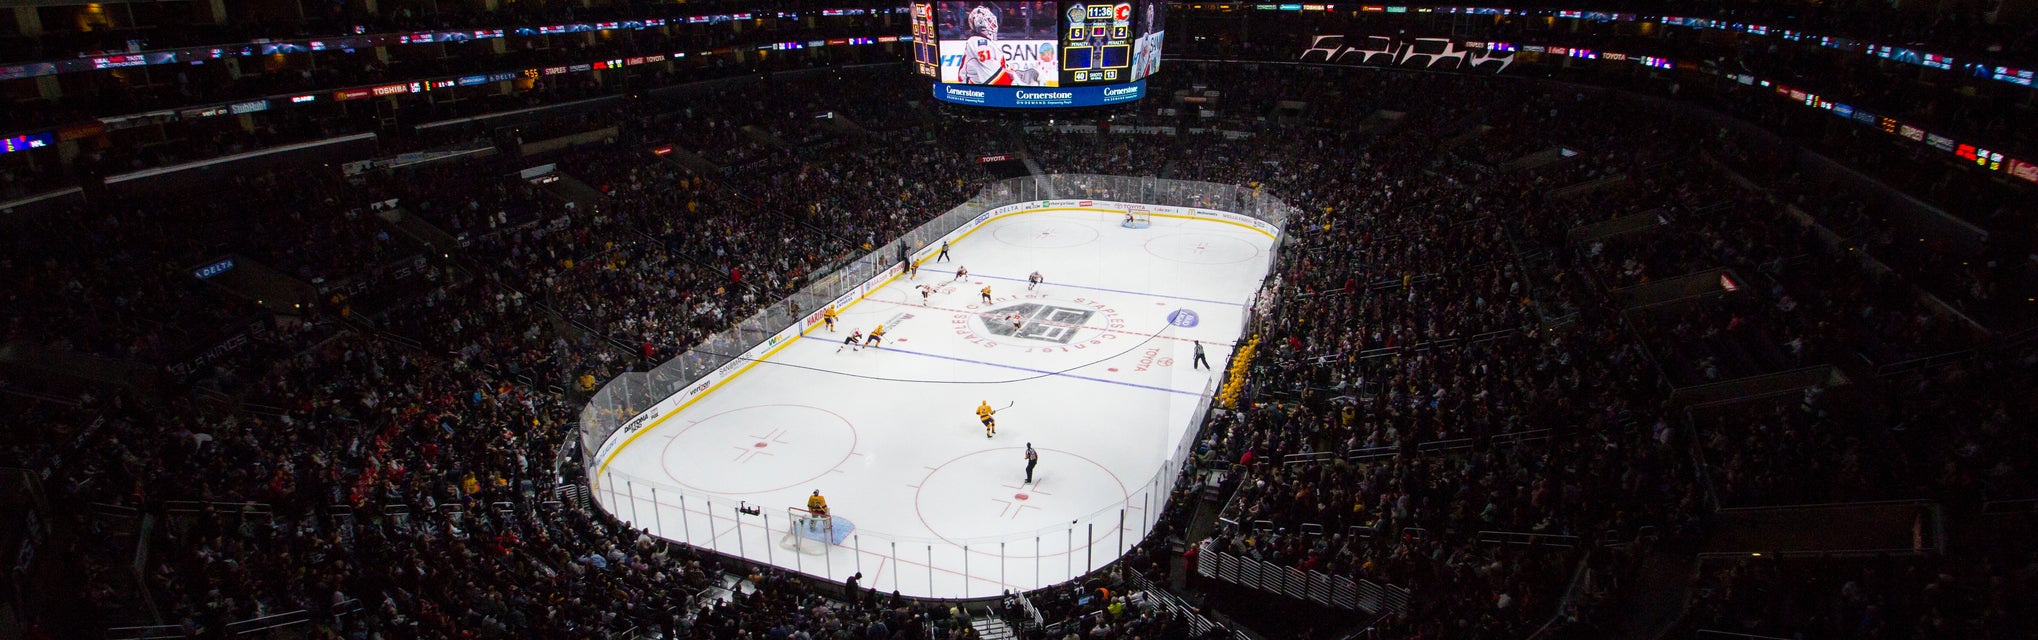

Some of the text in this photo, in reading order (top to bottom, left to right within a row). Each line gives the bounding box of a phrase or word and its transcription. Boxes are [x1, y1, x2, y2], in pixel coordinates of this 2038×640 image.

[1089, 7, 1111, 17] 11:36
[1118, 28, 1124, 36] 2
[978, 50, 991, 62] 31
[1001, 43, 1038, 60] SAN
[1602, 52, 1626, 61] TOYOTA
[646, 55, 666, 63] TOYOTA
[545, 66, 567, 75] STAPLES
[495, 73, 516, 81] DELTA
[373, 84, 408, 97] TOSHIBA
[946, 85, 985, 98] Cornerstone
[1016, 90, 1072, 99] Cornerstone
[1104, 86, 1138, 96] Cornerstone
[202, 108, 228, 117] verion
[231, 100, 267, 115] StubHub!
[1000, 205, 1018, 214] DELTA
[203, 259, 234, 276] DELTA
[1134, 348, 1160, 371] TOYOTA
[690, 380, 711, 396] verizon
[624, 414, 649, 434] DAYTONA
